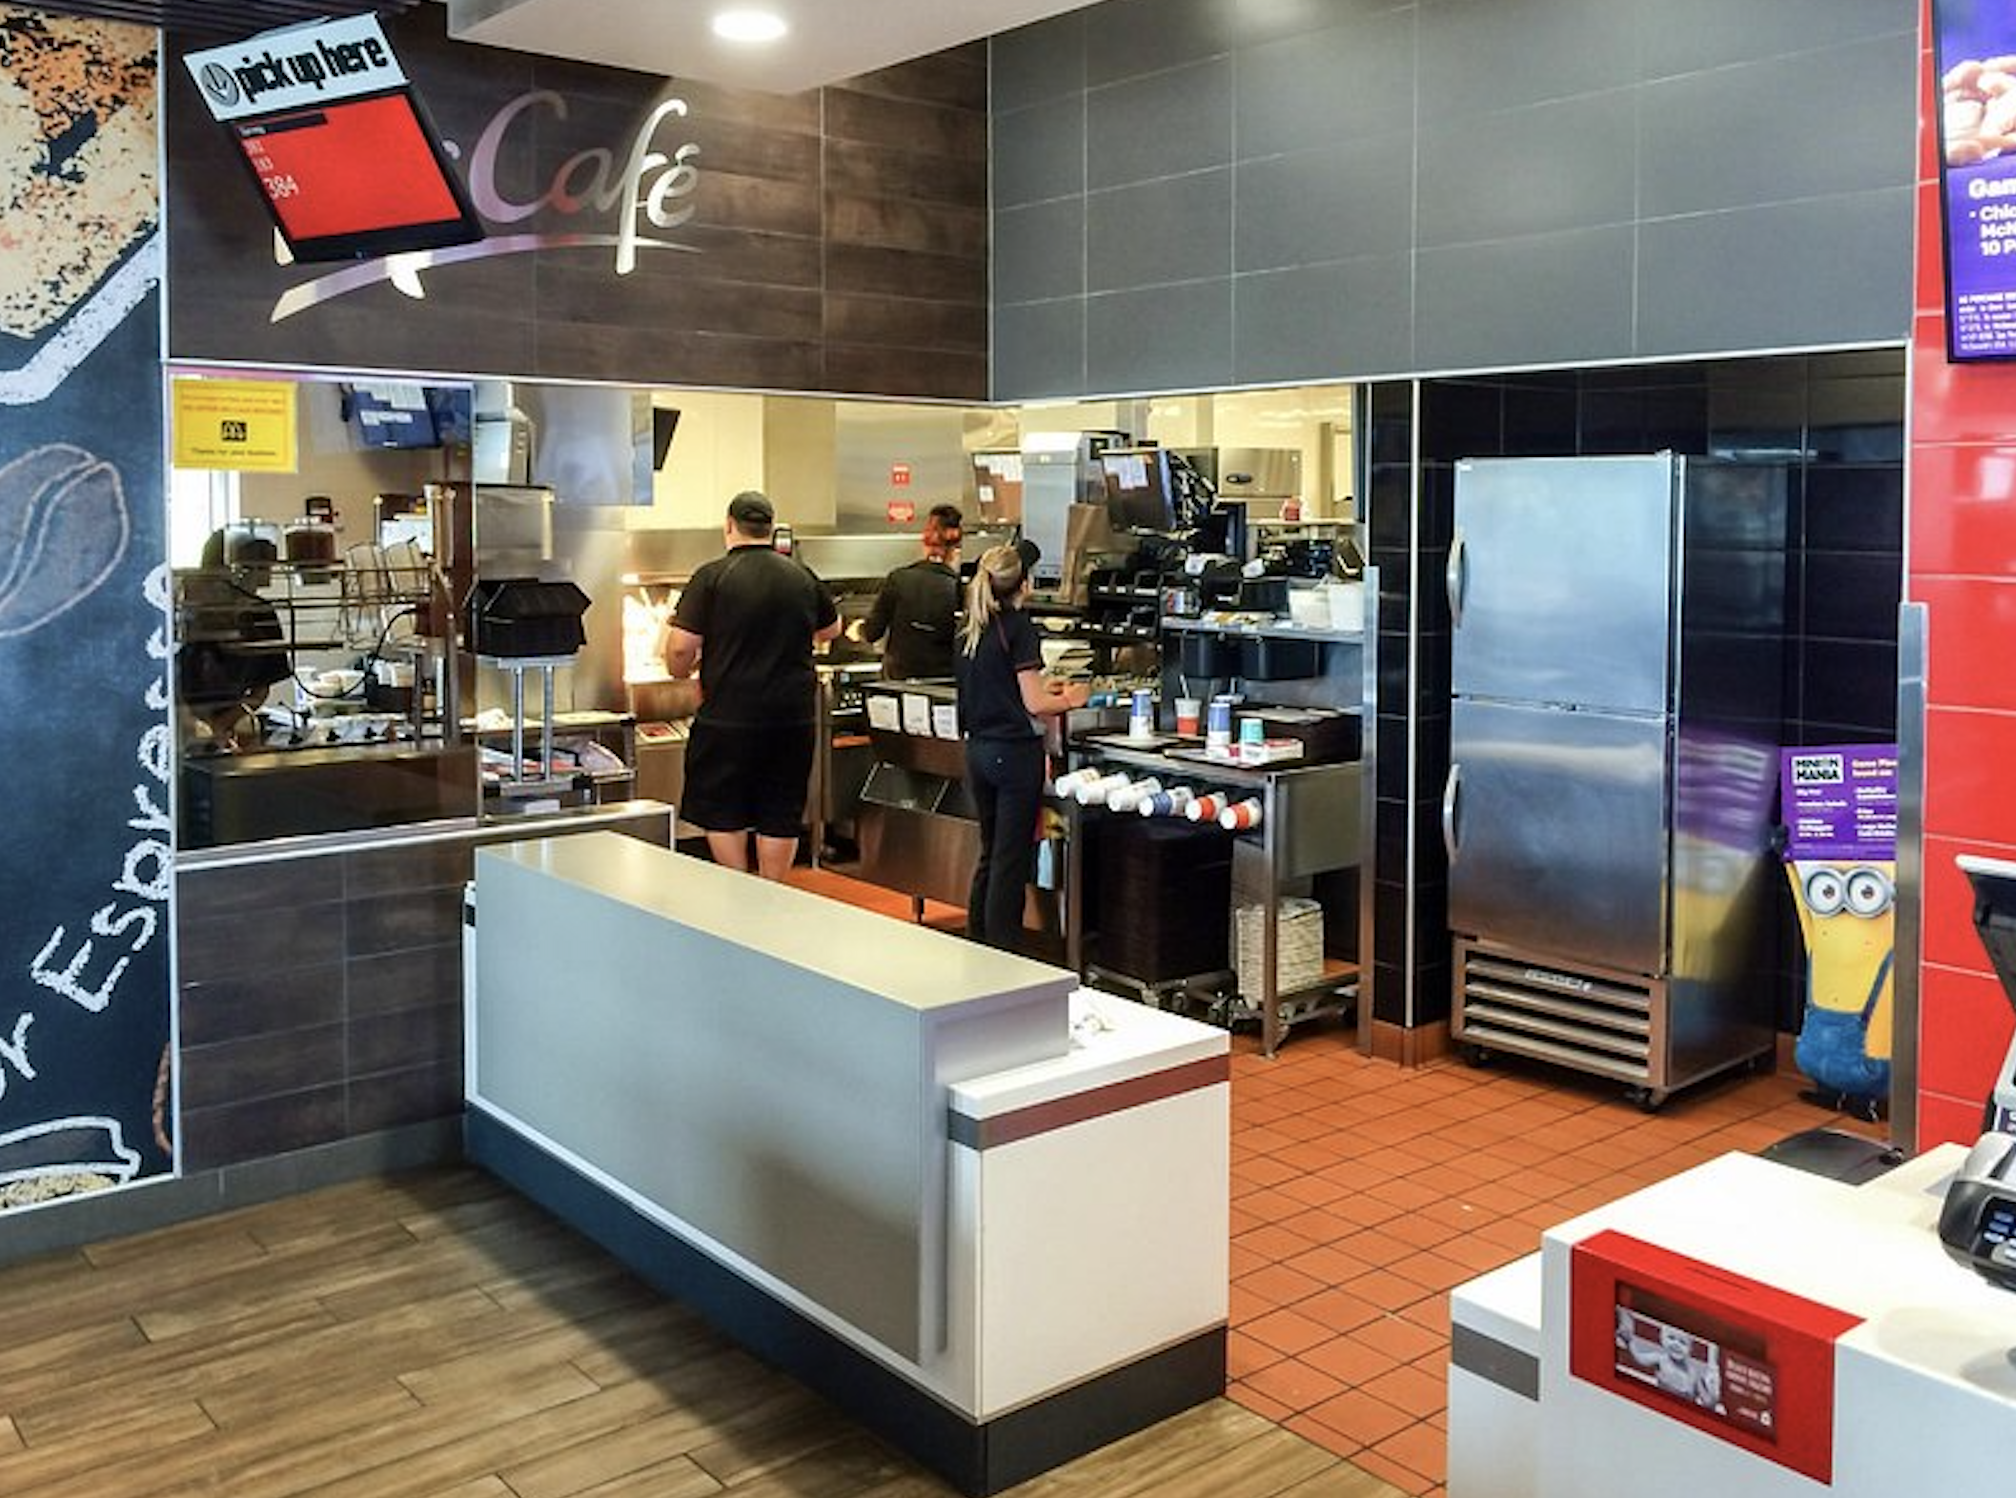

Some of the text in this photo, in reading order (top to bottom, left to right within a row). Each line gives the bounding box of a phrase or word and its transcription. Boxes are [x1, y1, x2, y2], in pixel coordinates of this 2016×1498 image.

[233, 37, 388, 103] pick up here
[262, 174, 300, 200] 384
[442, 89, 702, 274] Café
[1981, 239, 2001, 256] 10
